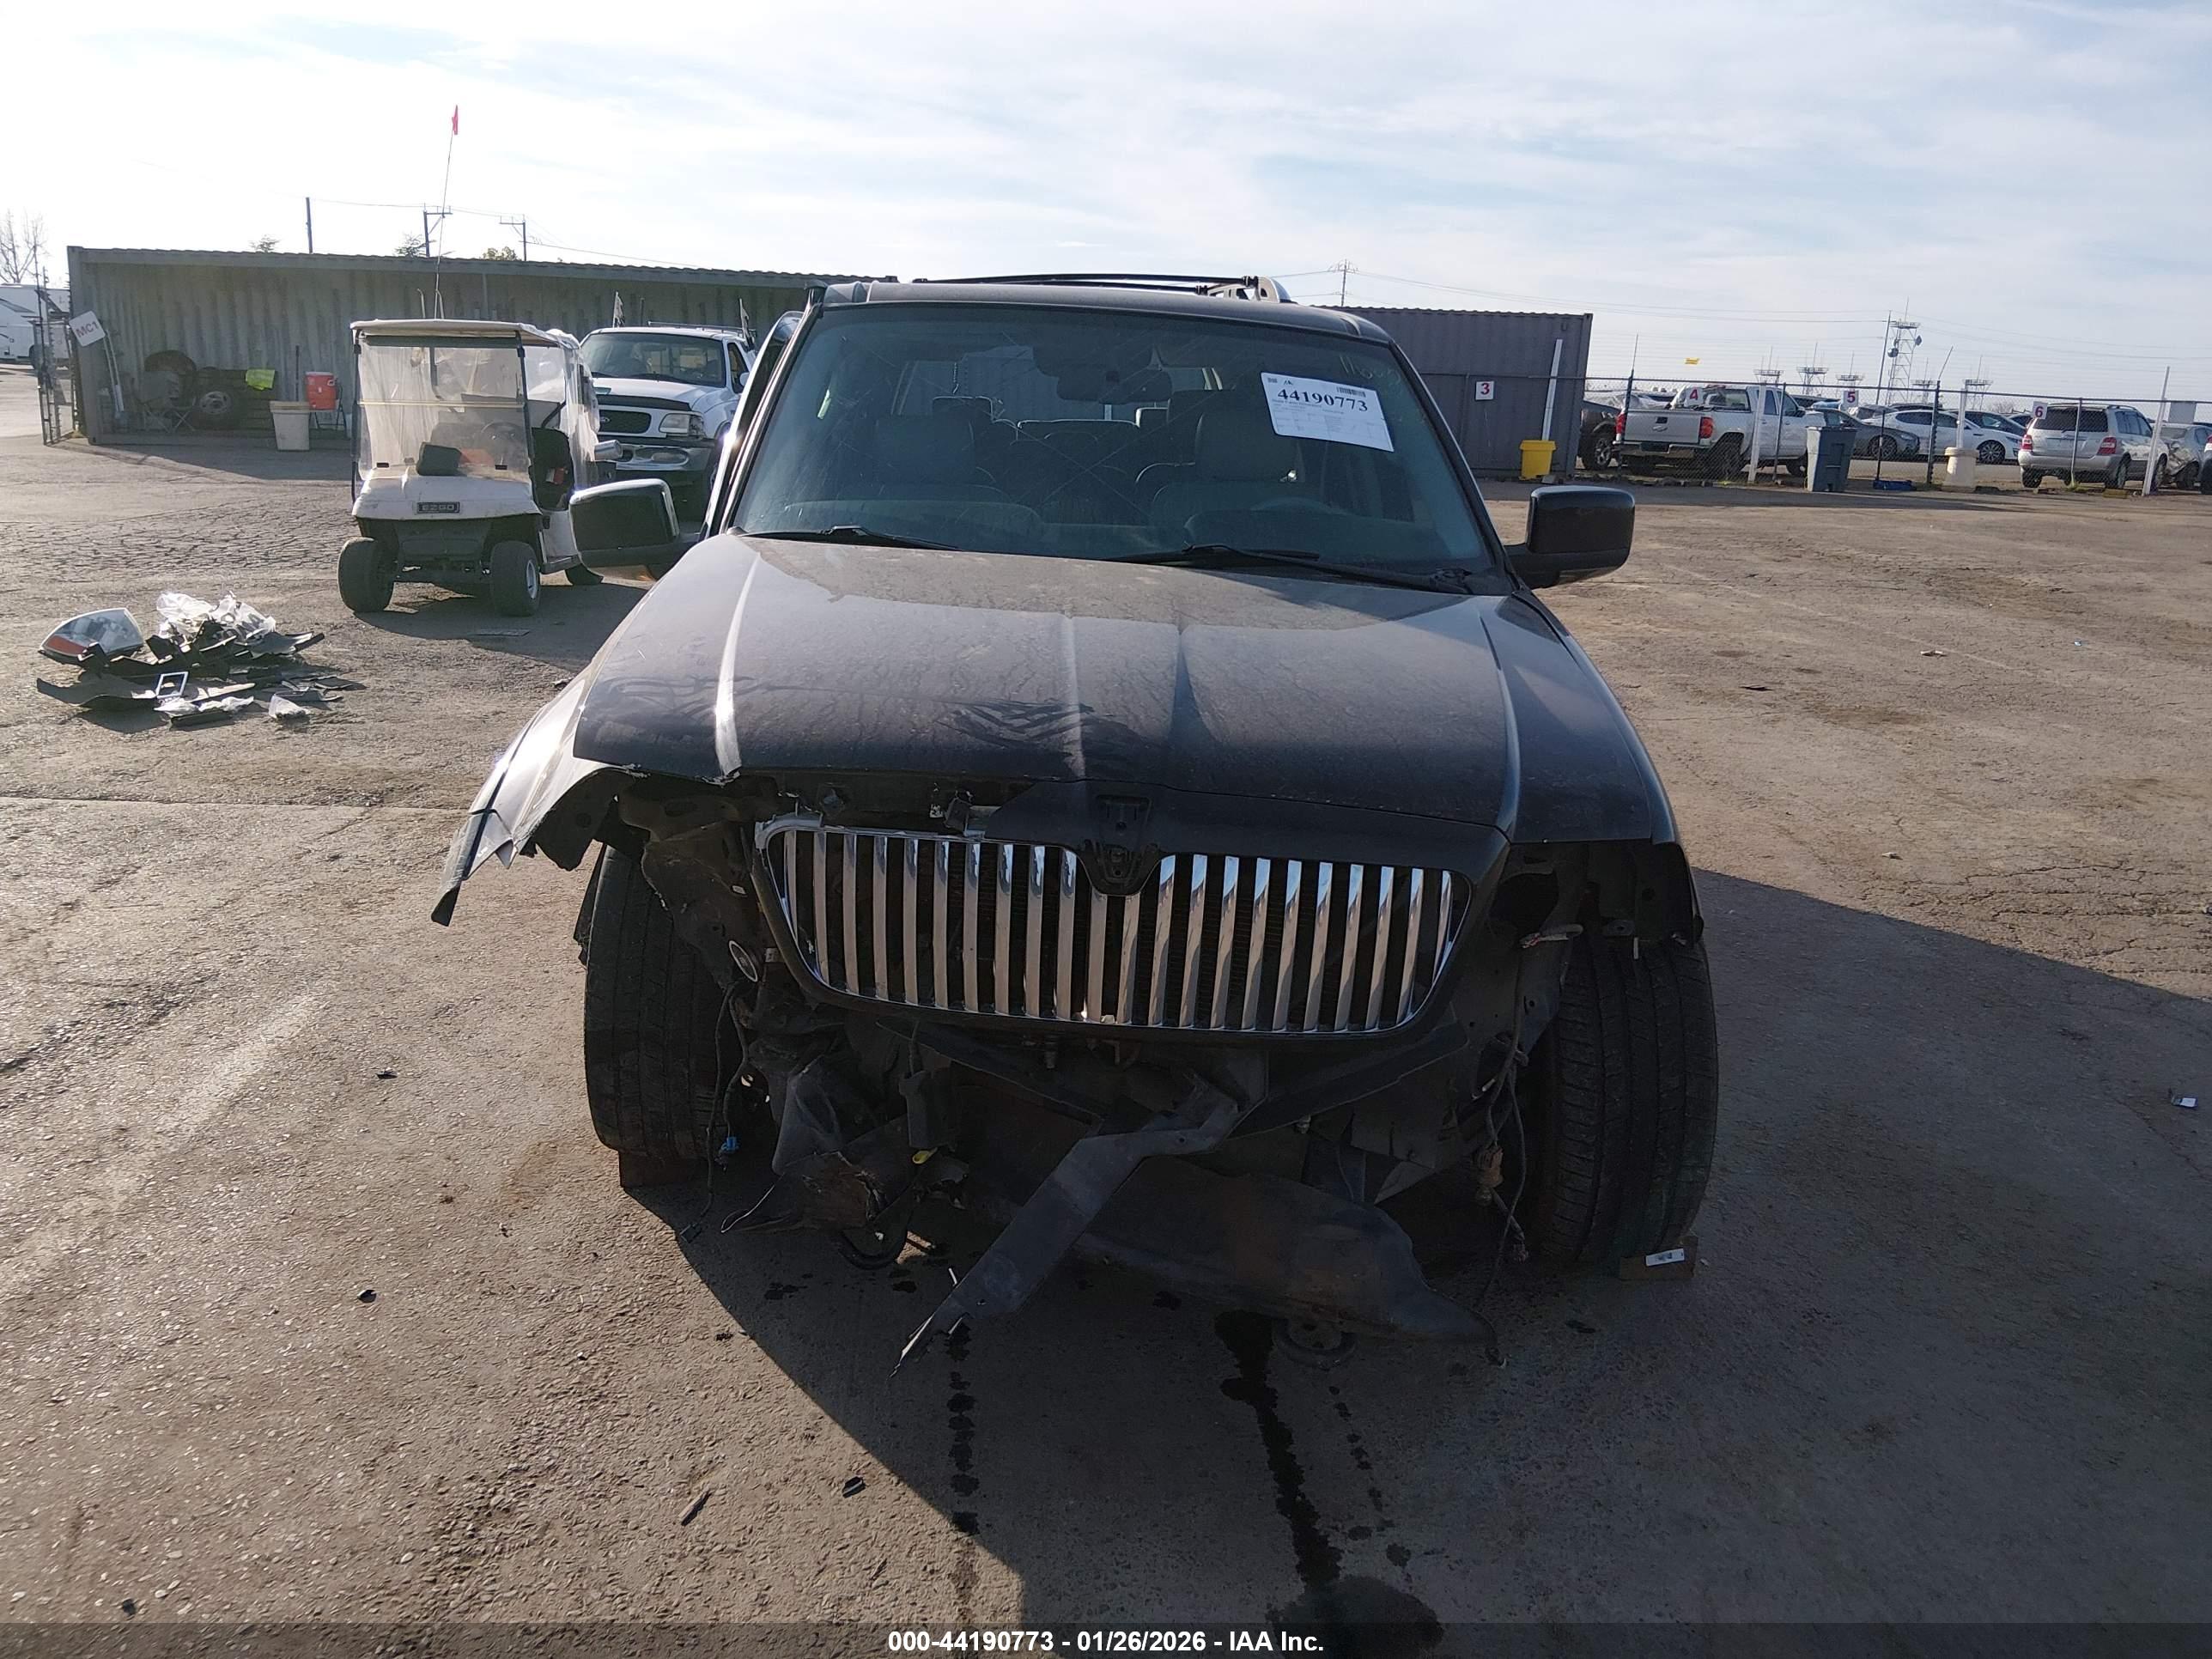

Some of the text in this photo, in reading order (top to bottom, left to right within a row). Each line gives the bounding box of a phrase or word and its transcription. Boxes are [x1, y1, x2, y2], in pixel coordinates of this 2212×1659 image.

[76, 320, 99, 338] MC1
[1480, 382, 1490, 395] 3
[1689, 388, 1698, 400] 4
[1277, 388, 1368, 412] 44190773
[1847, 391, 1856, 404] 5
[2035, 405, 2044, 417] 6
